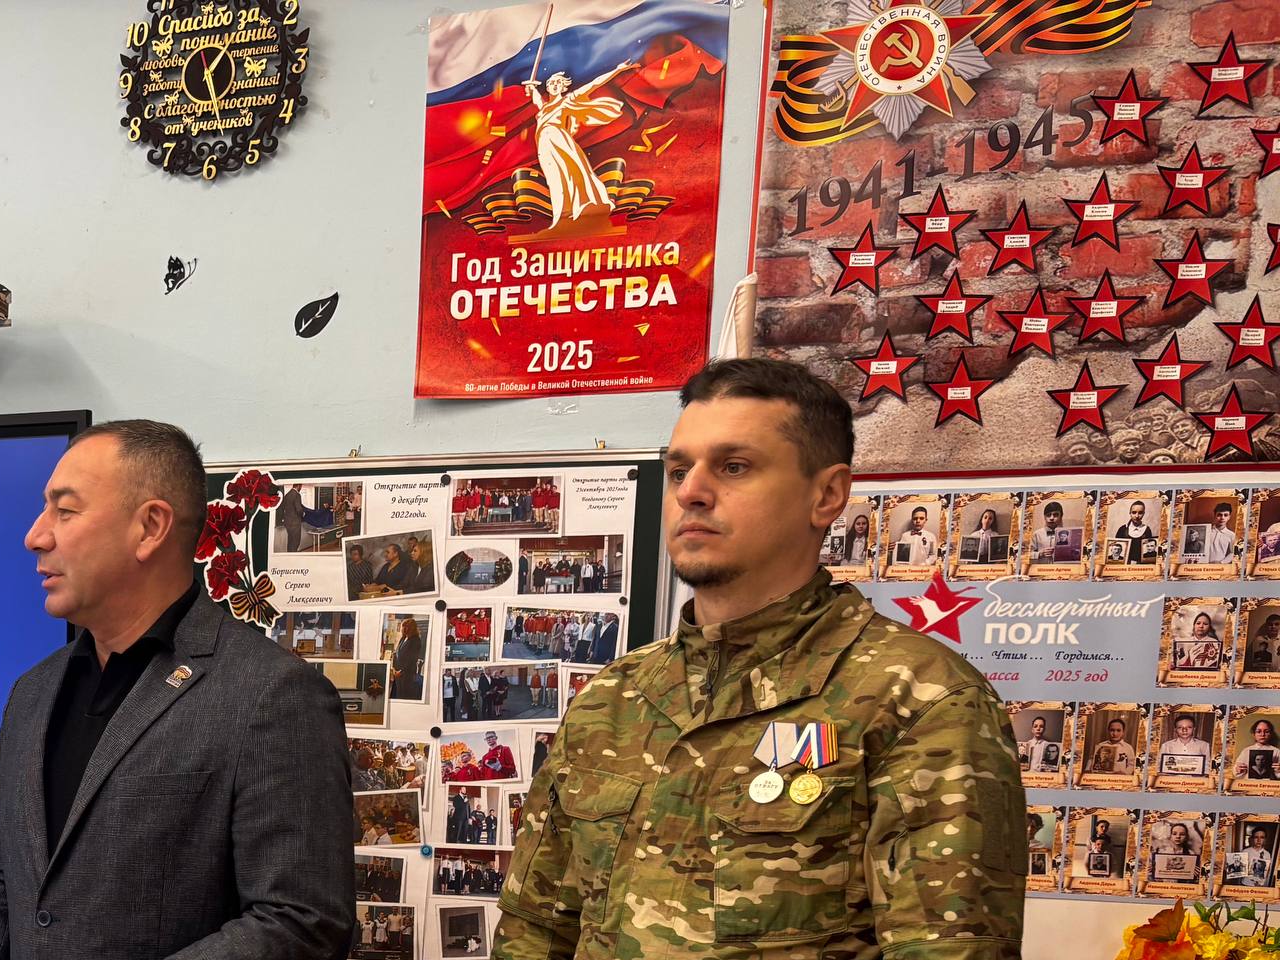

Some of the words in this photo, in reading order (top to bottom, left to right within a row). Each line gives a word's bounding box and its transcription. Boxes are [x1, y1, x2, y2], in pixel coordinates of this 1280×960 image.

[158, 6, 233, 36] Спасибо
[237, 6, 260, 30] за
[126, 21, 149, 48] 10
[180, 25, 278, 51] понимание,
[859, 8, 941, 86] ОТЕЧЕСТВЕННАЯ
[916, 33, 946, 84] ВОЙНА
[291, 47, 309, 74] 3
[119, 73, 133, 99] 9
[142, 79, 184, 96] заботу
[231, 73, 280, 94] знания!
[164, 121, 185, 135] от
[191, 111, 253, 137] учеников
[279, 98, 295, 124] 4
[127, 116, 142, 142] 8
[162, 142, 176, 167] 7
[245, 139, 261, 164] 5
[202, 154, 218, 180] 6
[450, 251, 503, 283] Год
[511, 240, 681, 279] Защитника
[450, 273, 678, 321] ОТЕЧЕСТВА
[526, 339, 593, 373] 2025
[464, 381, 499, 393] 80-летие
[500, 380, 530, 392] Победы
[537, 378, 570, 391] Великой
[571, 376, 629, 389] Отечественной
[629, 375, 654, 386] войне
[373, 482, 417, 492] Открытие
[391, 496, 397, 505] 9
[397, 495, 429, 506] декабря
[390, 510, 427, 520] 2022года.
[270, 567, 310, 577] Борисенко
[284, 581, 311, 591] Сергею
[983, 575, 1165, 623] бессмертный
[287, 595, 333, 605] Алексеевичу
[984, 623, 1080, 646] ПОЛК
[1044, 669, 1082, 682] 2025
[1084, 669, 1109, 682] год
